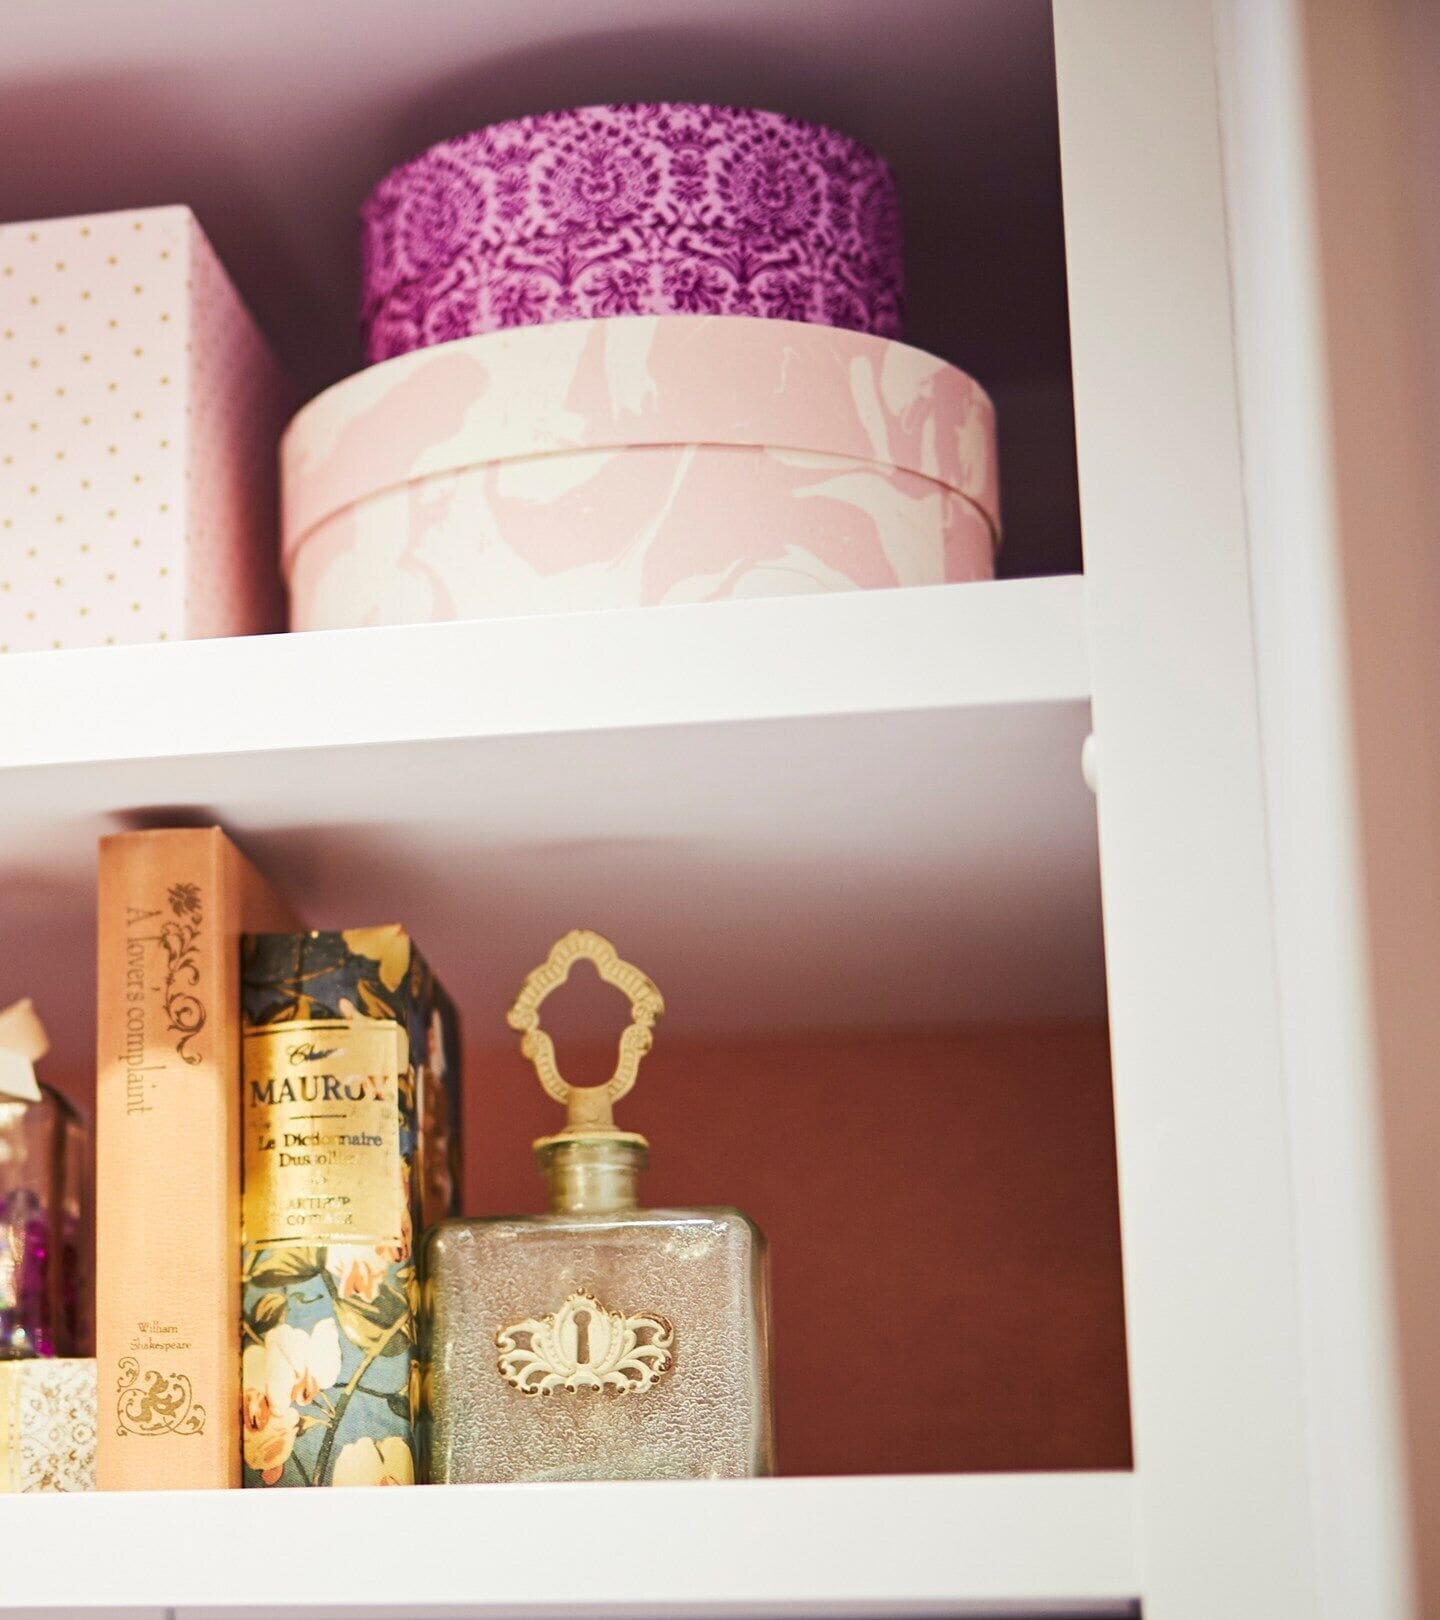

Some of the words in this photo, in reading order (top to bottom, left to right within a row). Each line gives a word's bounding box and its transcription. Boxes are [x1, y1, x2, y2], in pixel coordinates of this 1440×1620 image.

[126, 906, 162, 927] A
[119, 1006, 167, 1116] complaint
[251, 1073, 387, 1107] MAUROY
